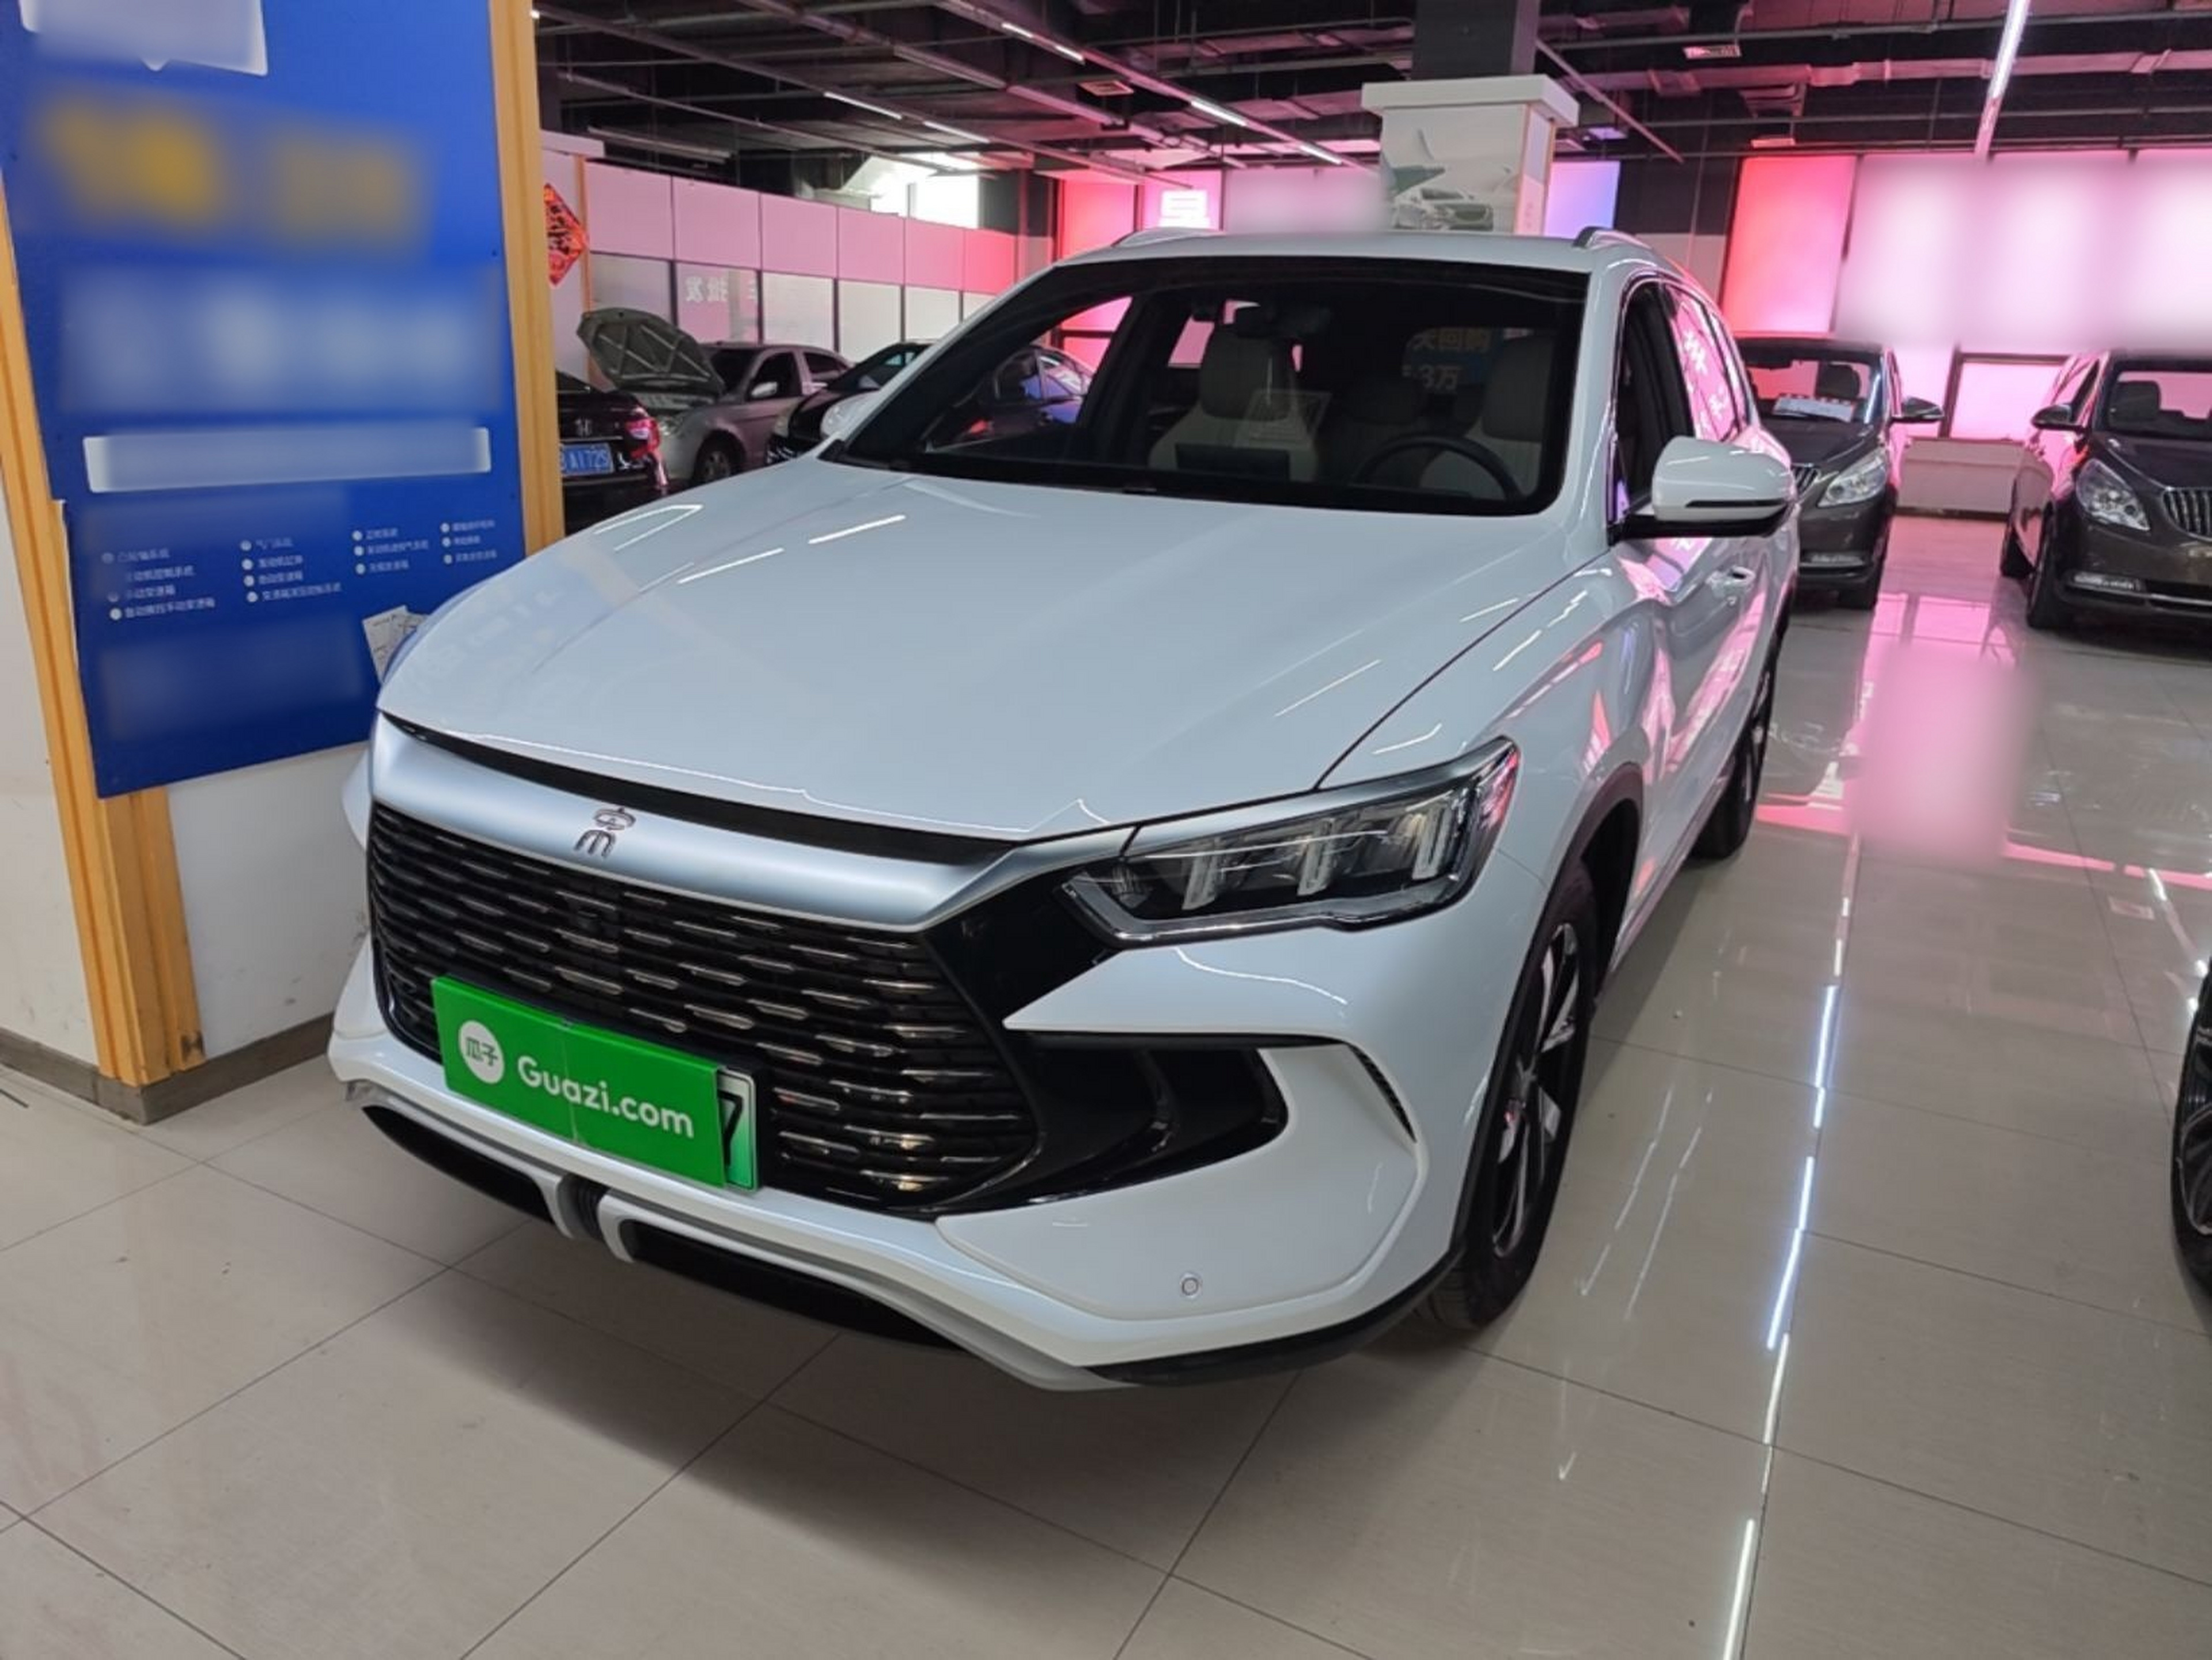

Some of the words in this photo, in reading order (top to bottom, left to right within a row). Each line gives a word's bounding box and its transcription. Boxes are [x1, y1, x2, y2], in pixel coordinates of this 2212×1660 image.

[126, 565, 194, 582] 动机控制系统
[464, 1037, 498, 1065] 瓜子
[517, 1056, 694, 1140] Guazi.com
[718, 1090, 743, 1167] 7
